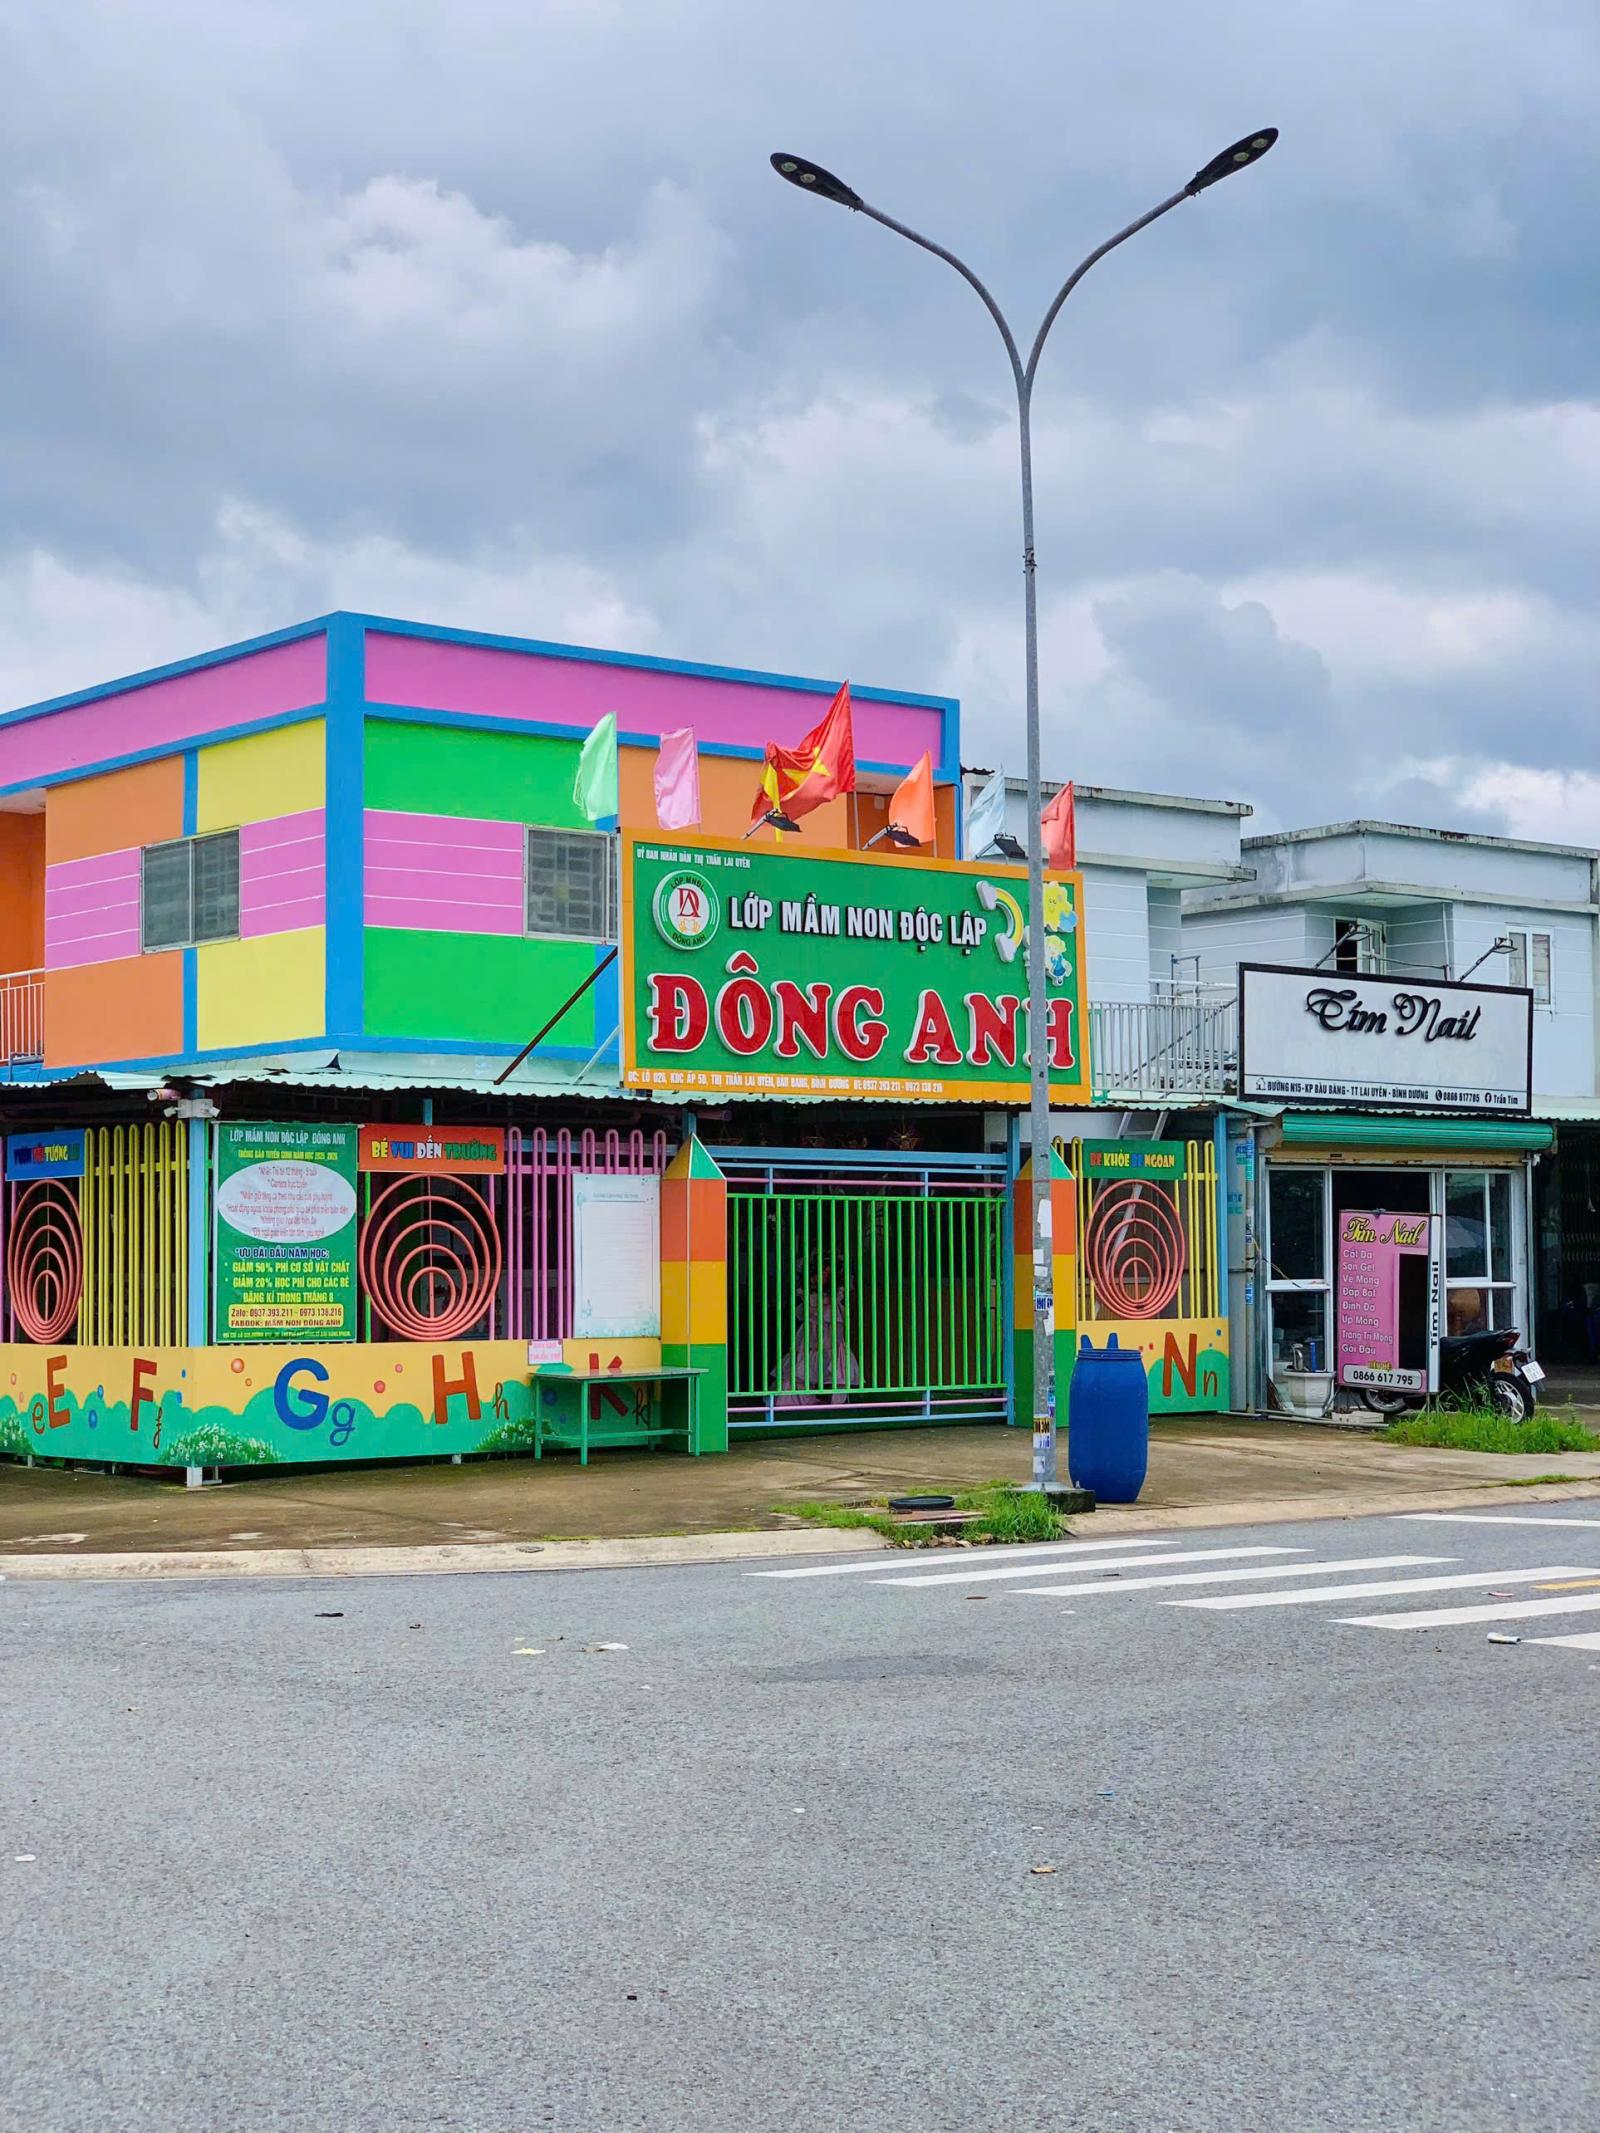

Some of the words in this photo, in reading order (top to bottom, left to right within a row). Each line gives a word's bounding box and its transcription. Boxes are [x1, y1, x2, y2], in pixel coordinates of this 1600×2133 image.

[730, 891, 773, 930] LỚP
[781, 892, 840, 935] MẦM
[846, 906, 893, 939] NON
[899, 906, 943, 951] ĐỘC
[950, 909, 987, 955] LẬP
[647, 950, 889, 1061] ĐÔNG
[903, 989, 1075, 1069] ANH
[1393, 992, 1481, 1042] Nail
[1351, 1086, 1359, 1096] TT
[1360, 1087, 1370, 1097] LAI
[1392, 1087, 1406, 1098] BÌNH
[371, 1137, 389, 1158] BÉ
[390, 1141, 415, 1158] VUI
[416, 1135, 442, 1159] ĐẾN
[444, 1138, 497, 1161] TRƯỜNG
[1103, 1149, 1130, 1167] KHỎE
[1144, 1153, 1175, 1168] NGOAN
[1379, 1219, 1427, 1245] Nail
[256, 1263, 273, 1273] 50%
[255, 1277, 272, 1288] 20%
[306, 1277, 322, 1288] CHO
[276, 1293, 301, 1303] TRONG
[231, 1308, 248, 1317] Zalo:
[1162, 1332, 1197, 1397] N
[1353, 1370, 1375, 1381] 0866
[1377, 1373, 1393, 1383] 617
[1397, 1374, 1413, 1385] 795
[46, 1354, 71, 1429] E
[130, 1358, 157, 1431] F
[274, 1357, 330, 1431] G
[431, 1351, 481, 1425] H
